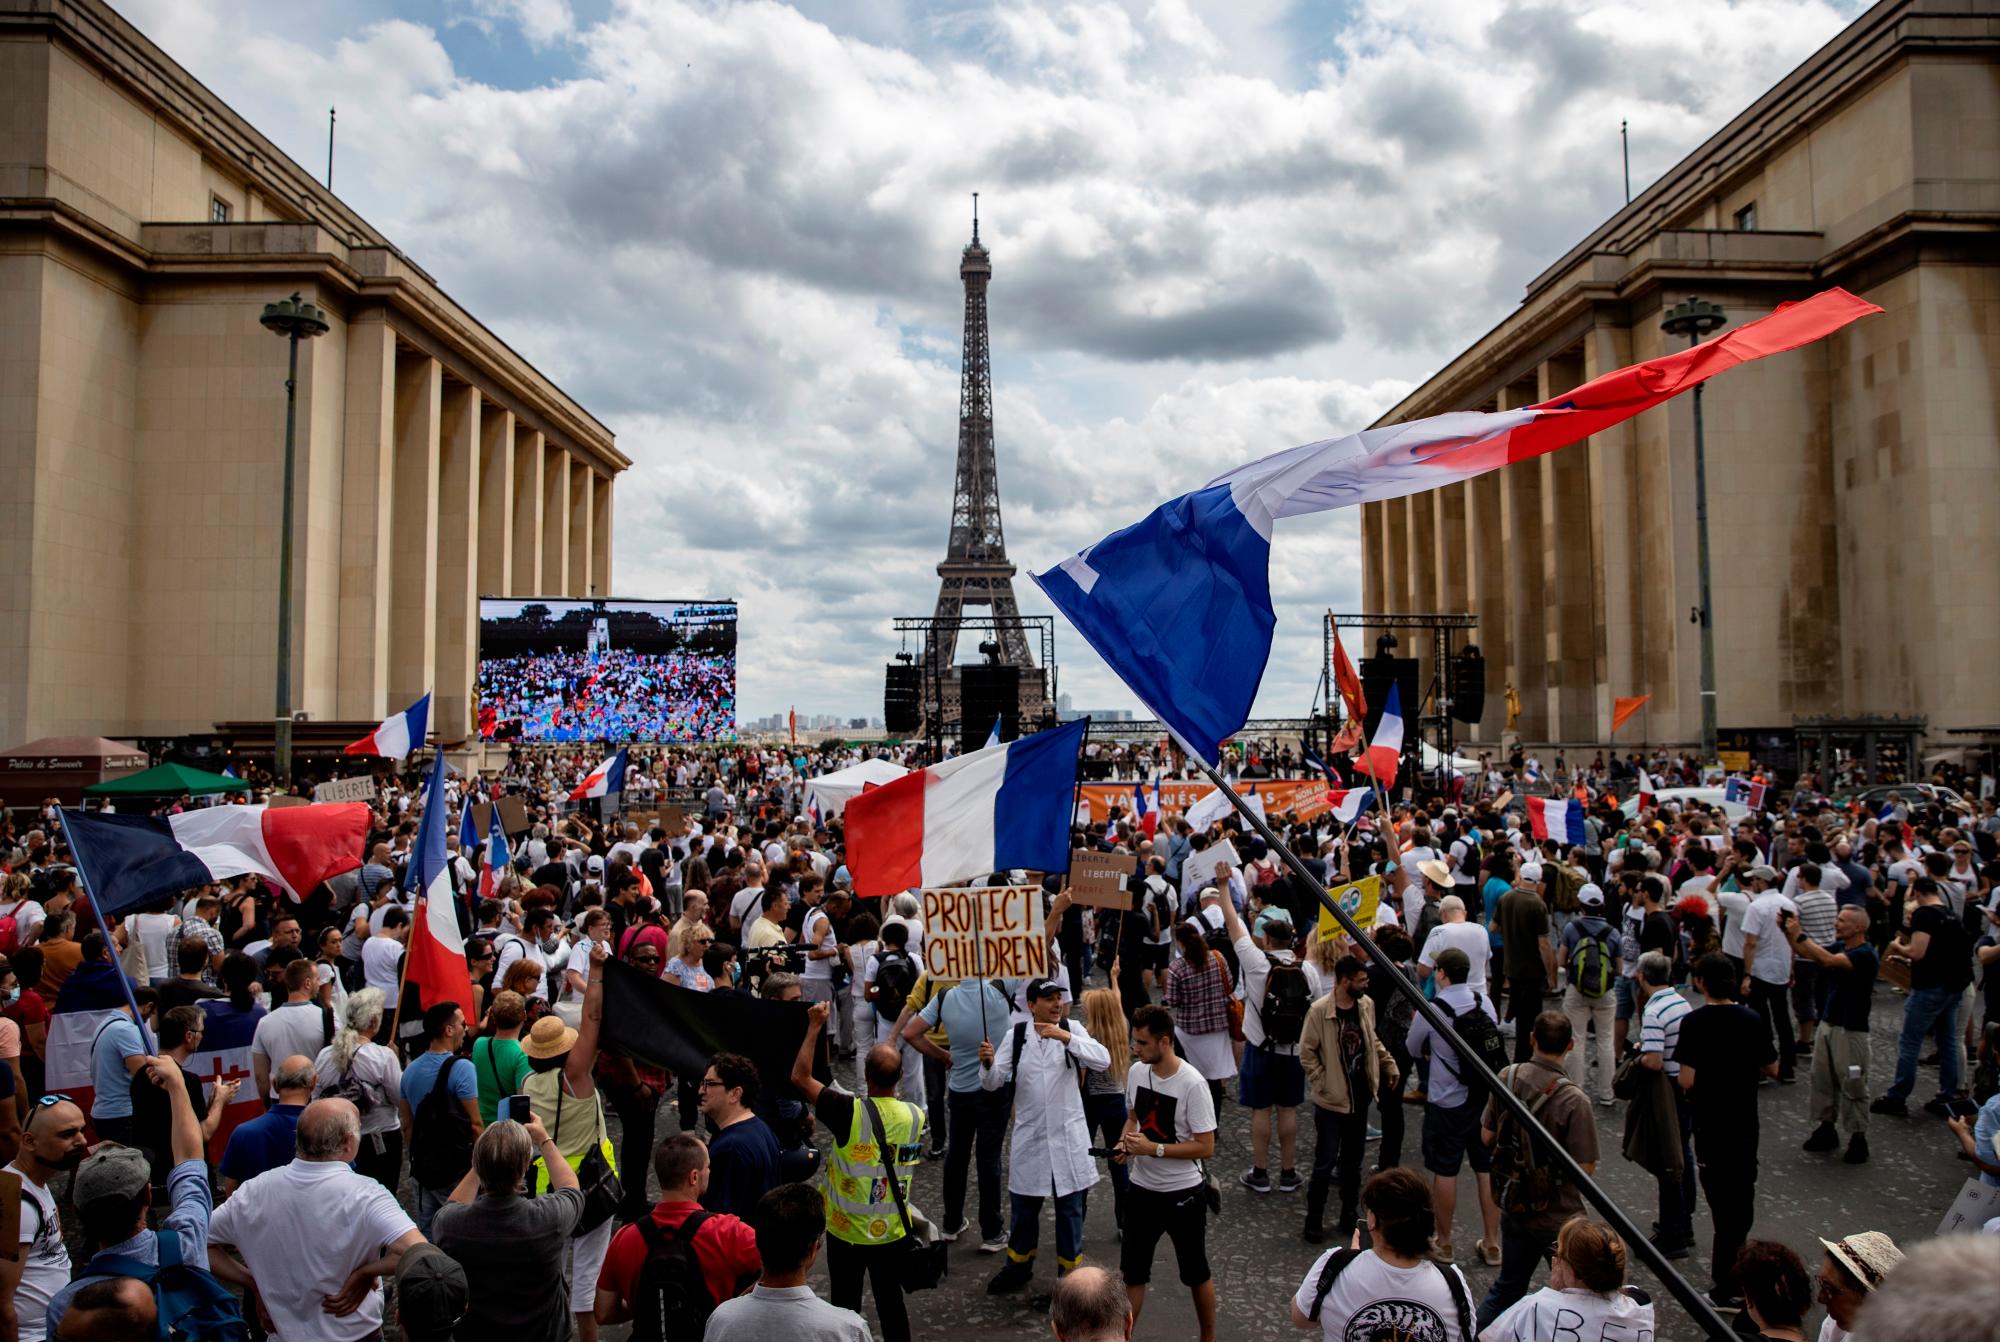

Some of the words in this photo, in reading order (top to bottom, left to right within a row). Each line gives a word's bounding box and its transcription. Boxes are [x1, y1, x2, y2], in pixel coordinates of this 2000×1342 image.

[8, 758, 34, 769] Palais
[37, 759, 46, 769] de
[923, 887, 1038, 934] PROTECT
